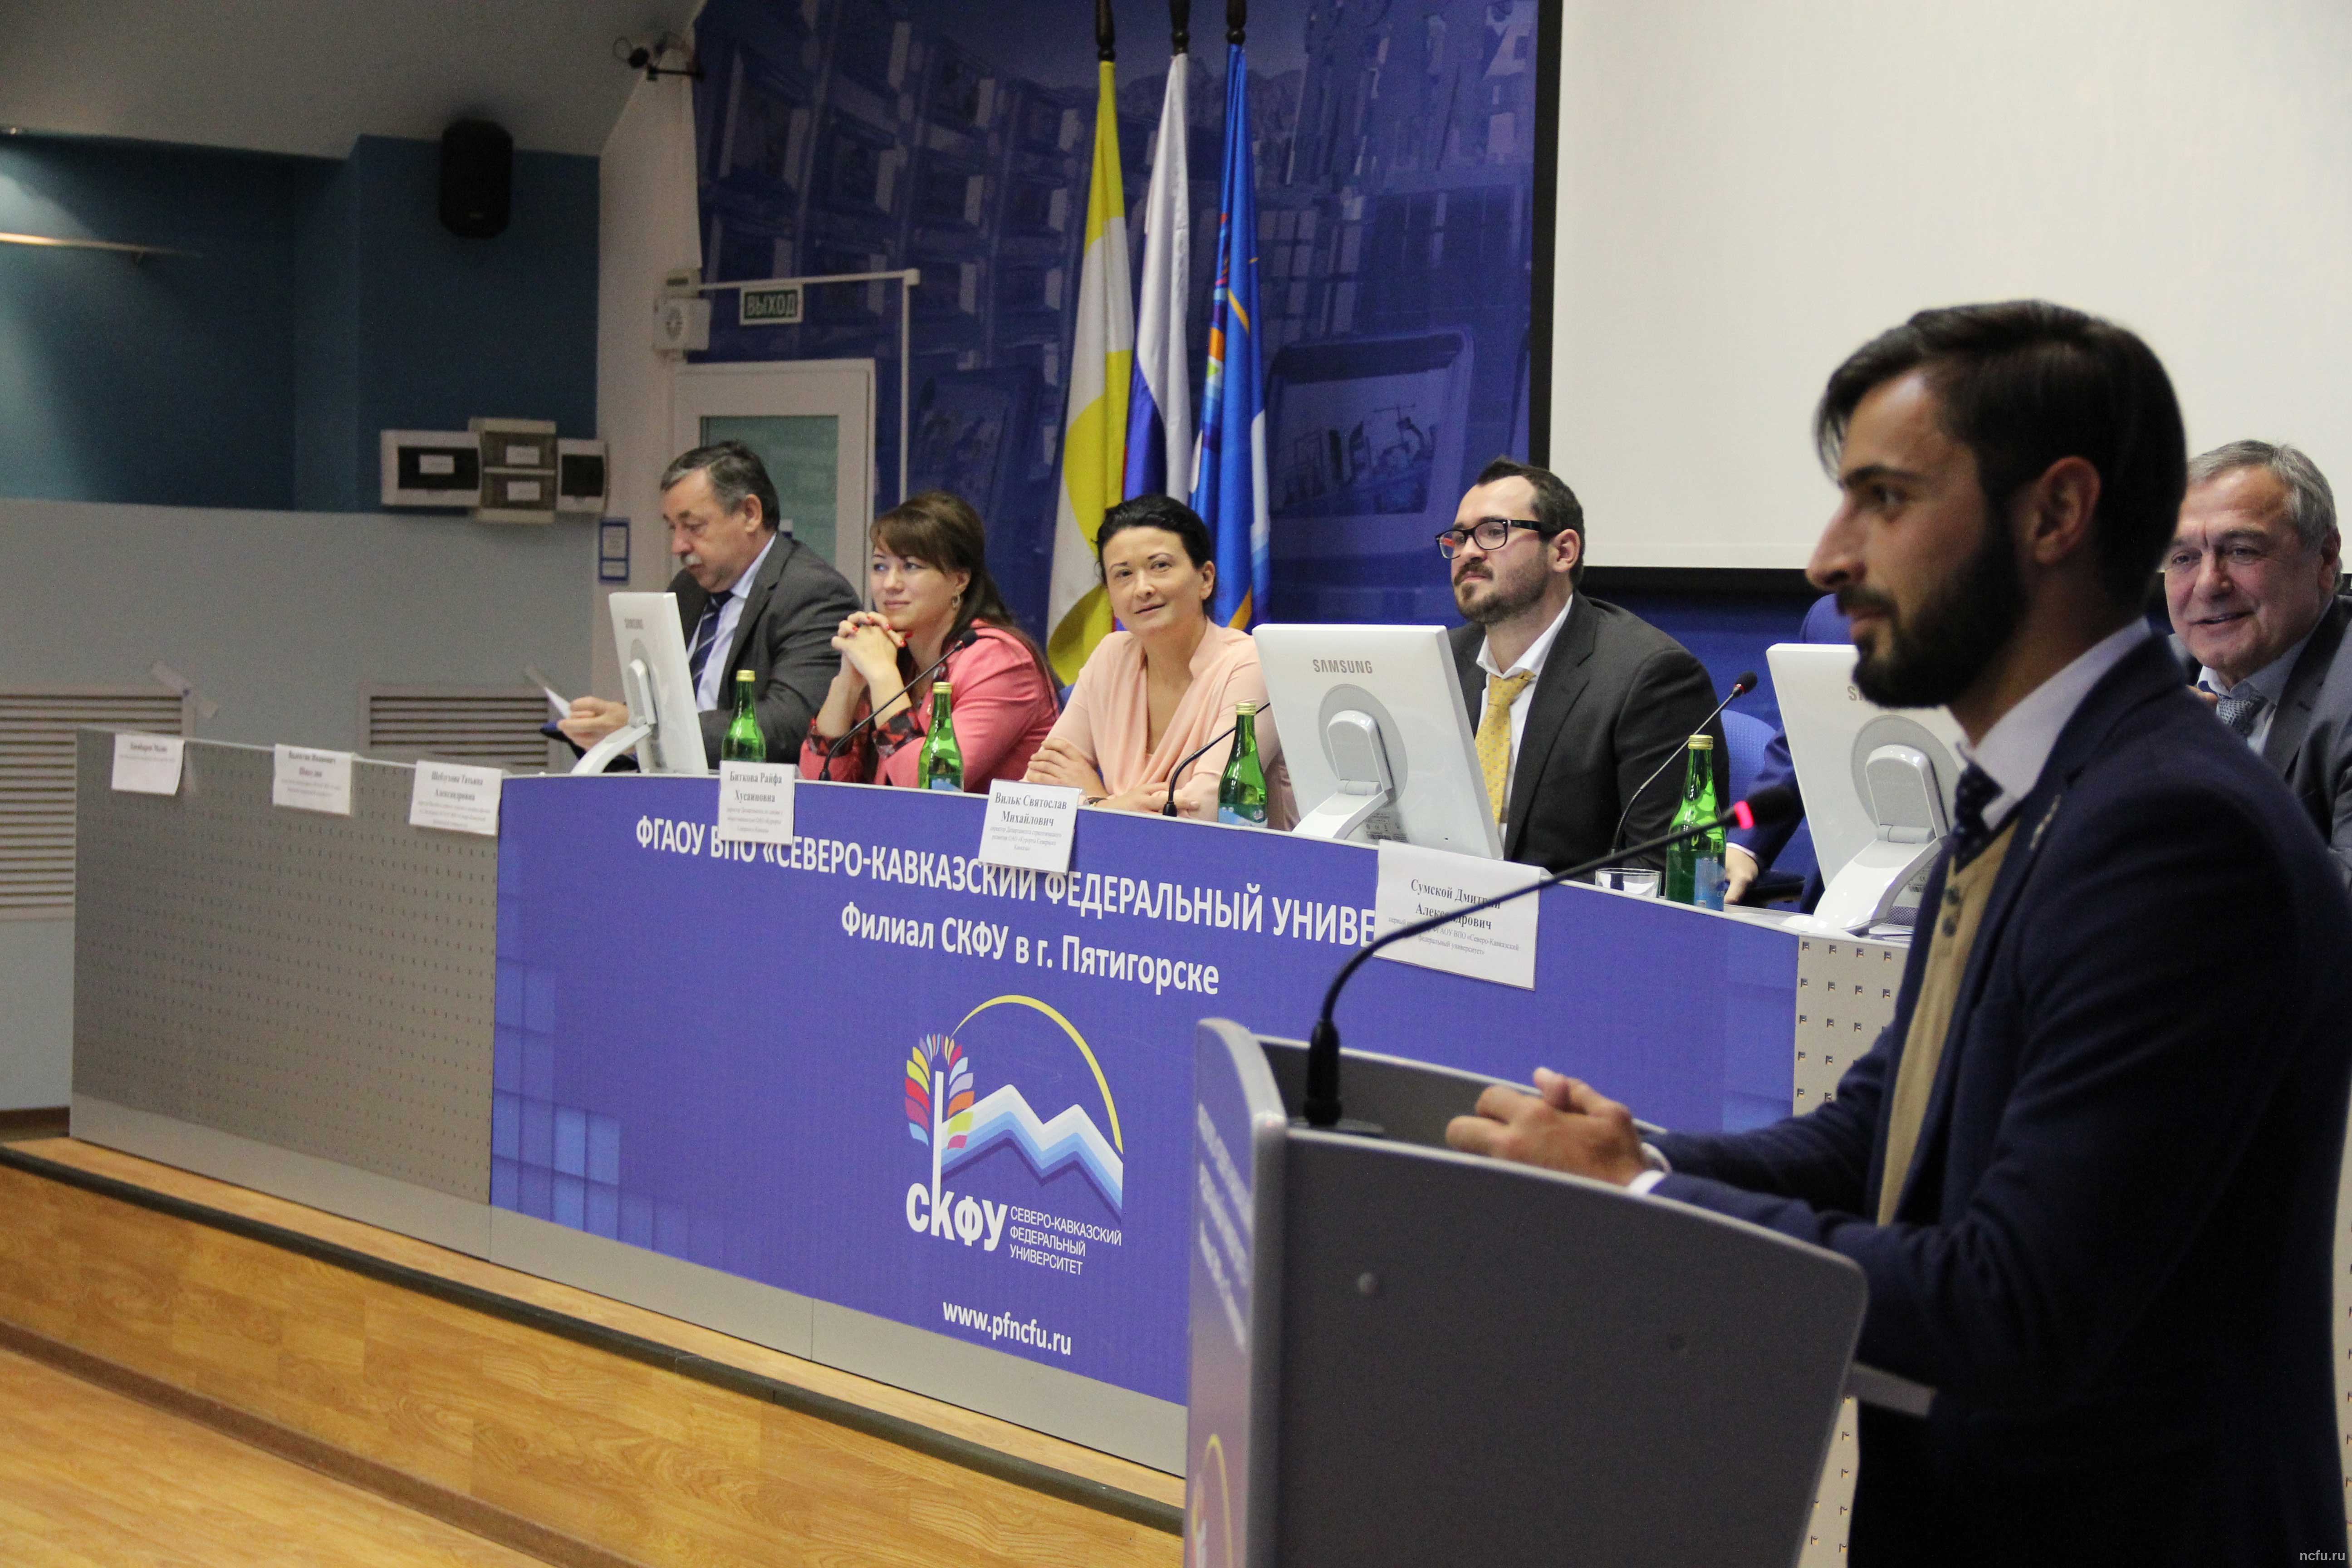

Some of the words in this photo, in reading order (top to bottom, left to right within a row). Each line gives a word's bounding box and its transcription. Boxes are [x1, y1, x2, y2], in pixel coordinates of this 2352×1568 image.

[747, 293, 797, 316] ВЫХОД
[1313, 659, 1373, 674] SAMSUNG
[995, 792, 1021, 805] Вильк
[1023, 795, 1067, 809] Святослав
[1001, 810, 1054, 827] Михайлович
[636, 815, 706, 855] ФГАОУ
[1045, 871, 1263, 933] ФЕДЕРАЛЬНЫЙ
[1411, 879, 1452, 899] Сумской
[842, 902, 935, 949] Филиал
[941, 917, 1009, 960] СКФУ
[1015, 936, 1029, 964] в
[1037, 940, 1053, 969] г.
[1062, 934, 1220, 995] Пятигорске
[1454, 930, 1466, 940] ВПО
[1010, 1206, 1122, 1246] СЕВЕРО-КАВКАЗСКИЙ
[1010, 1225, 1086, 1257] ФЕДЕРАЛЬНЫЙ
[1009, 1244, 1083, 1275] УНИВЕРСИТЕТ
[943, 1302, 1072, 1355] www.pfncfu.ru
